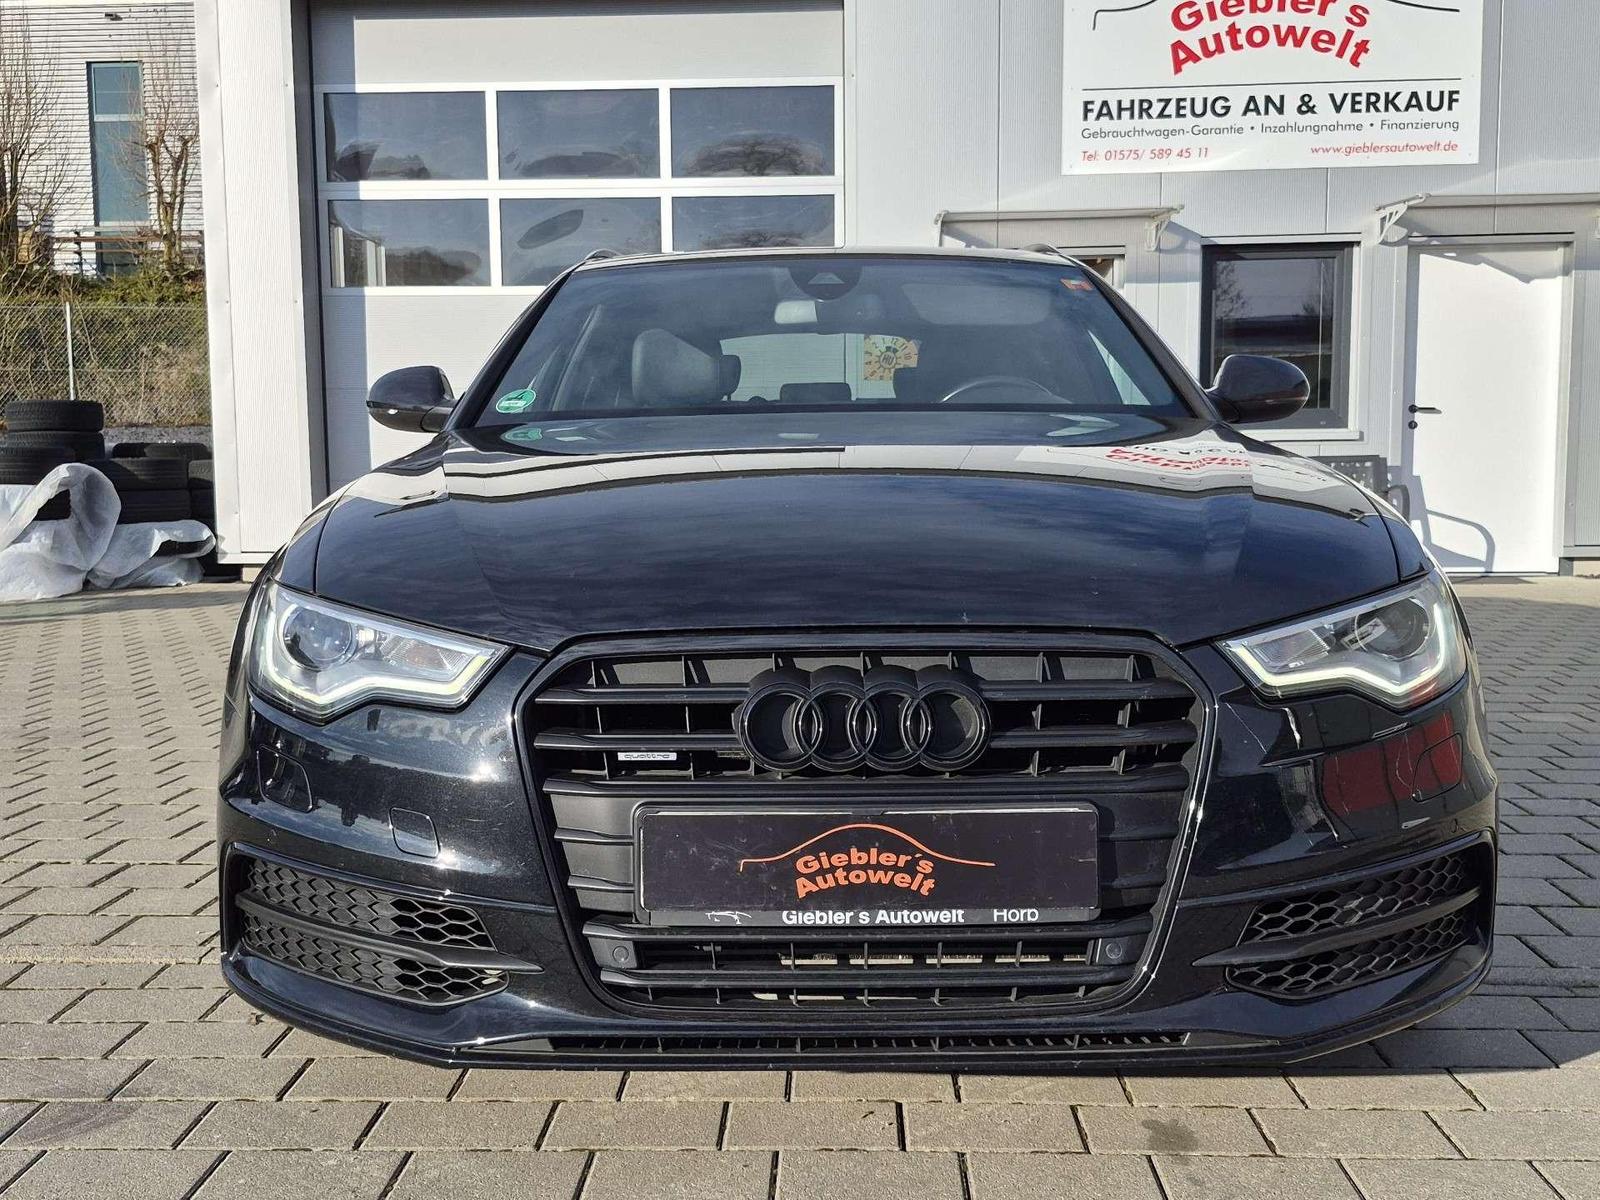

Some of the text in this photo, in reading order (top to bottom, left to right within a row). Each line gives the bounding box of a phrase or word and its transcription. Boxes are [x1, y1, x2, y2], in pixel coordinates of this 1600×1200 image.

[1170, 20, 1371, 76] Autowelt
[1082, 90, 1460, 122] FAHRZEUG AN & VERKAUF
[1081, 118, 1460, 139] Gebrauchtwagen-Garantie Inzahlungnahme Finanzierung
[1150, 148, 1172, 160] 589
[1176, 148, 1192, 160] 45
[1198, 147, 1209, 159] 11
[1310, 140, 1459, 157] www.gieblersautowelt.de
[795, 867, 936, 900] Autowelt
[875, 909, 965, 924] Autowelt
[993, 907, 1040, 922] Horb
